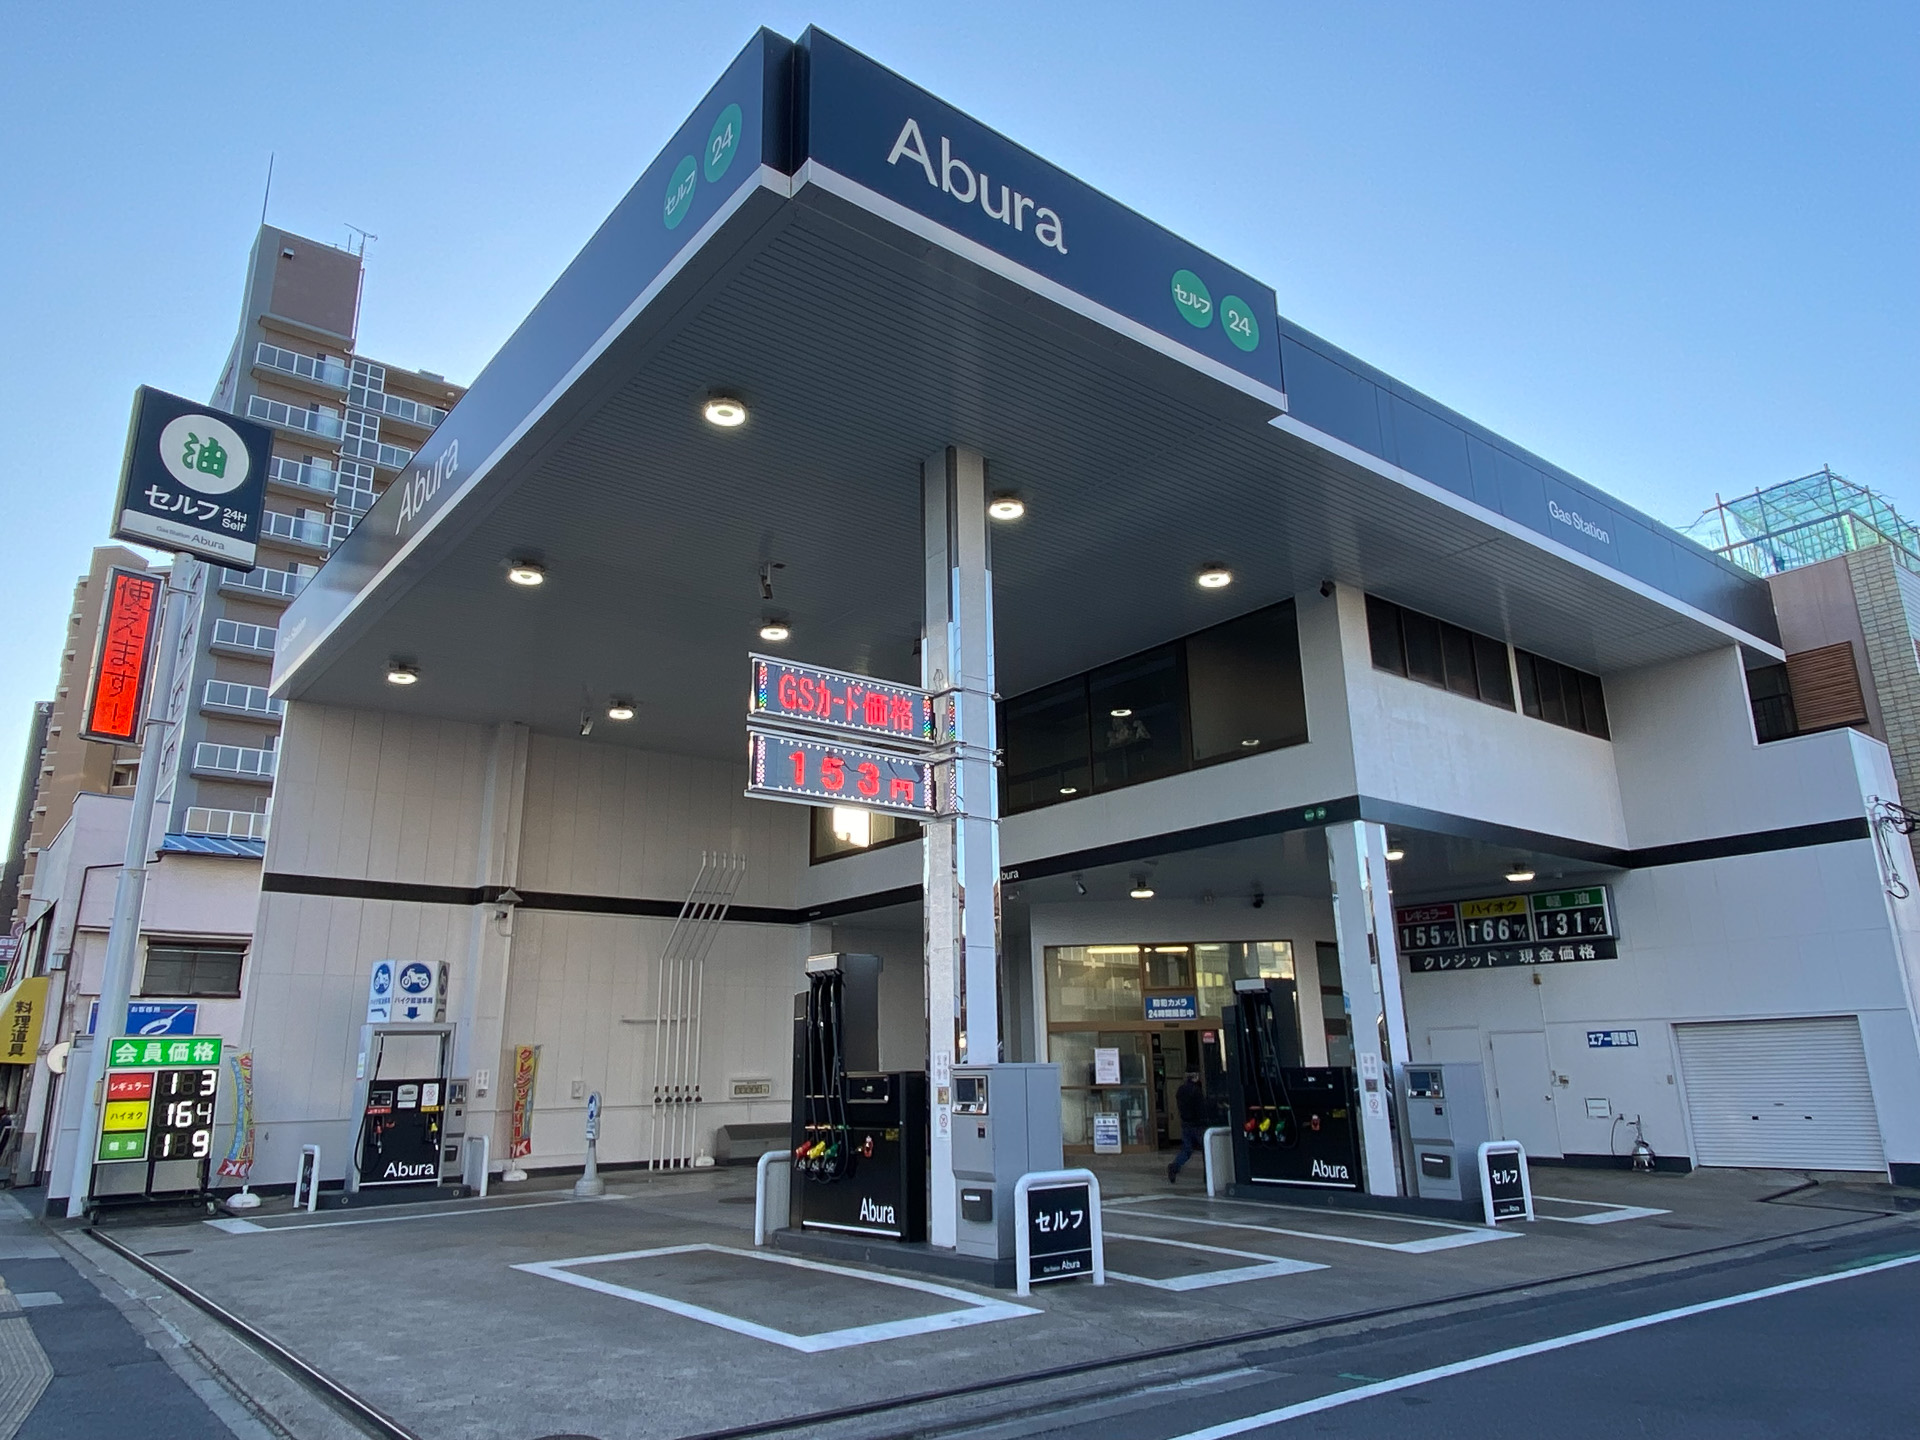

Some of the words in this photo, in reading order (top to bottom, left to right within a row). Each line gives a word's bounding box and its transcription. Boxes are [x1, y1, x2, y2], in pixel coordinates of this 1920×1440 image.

[711, 122, 734, 166] 24
[665, 170, 696, 216] セルフ
[886, 118, 1069, 255] Abura
[1174, 283, 1211, 314] セルフ
[1228, 309, 1252, 337] 24
[182, 432, 228, 479] 油
[394, 438, 459, 536] Abura
[144, 484, 220, 521] セルフ
[221, 518, 247, 532] Self
[223, 507, 248, 523] 24H
[1548, 500, 1572, 526] Gas
[1571, 511, 1610, 545] Station
[191, 534, 225, 550] Abura
[778, 673, 914, 731] GSカード価格
[1000, 870, 1019, 881] bura
[1404, 908, 1448, 921] レギュラー
[1471, 900, 1518, 914] ハイオク
[7, 1000, 33, 1057] 料理道具
[115, 1042, 215, 1063] 会員価格
[110, 1082, 150, 1092] レギュラー
[110, 1111, 144, 1120] ハイオク
[383, 1161, 435, 1178] Abura
[1311, 1159, 1349, 1179] Abura
[1491, 1169, 1518, 1185] セルフ
[859, 1197, 896, 1225] Abura
[1035, 1210, 1083, 1232] セルフ
